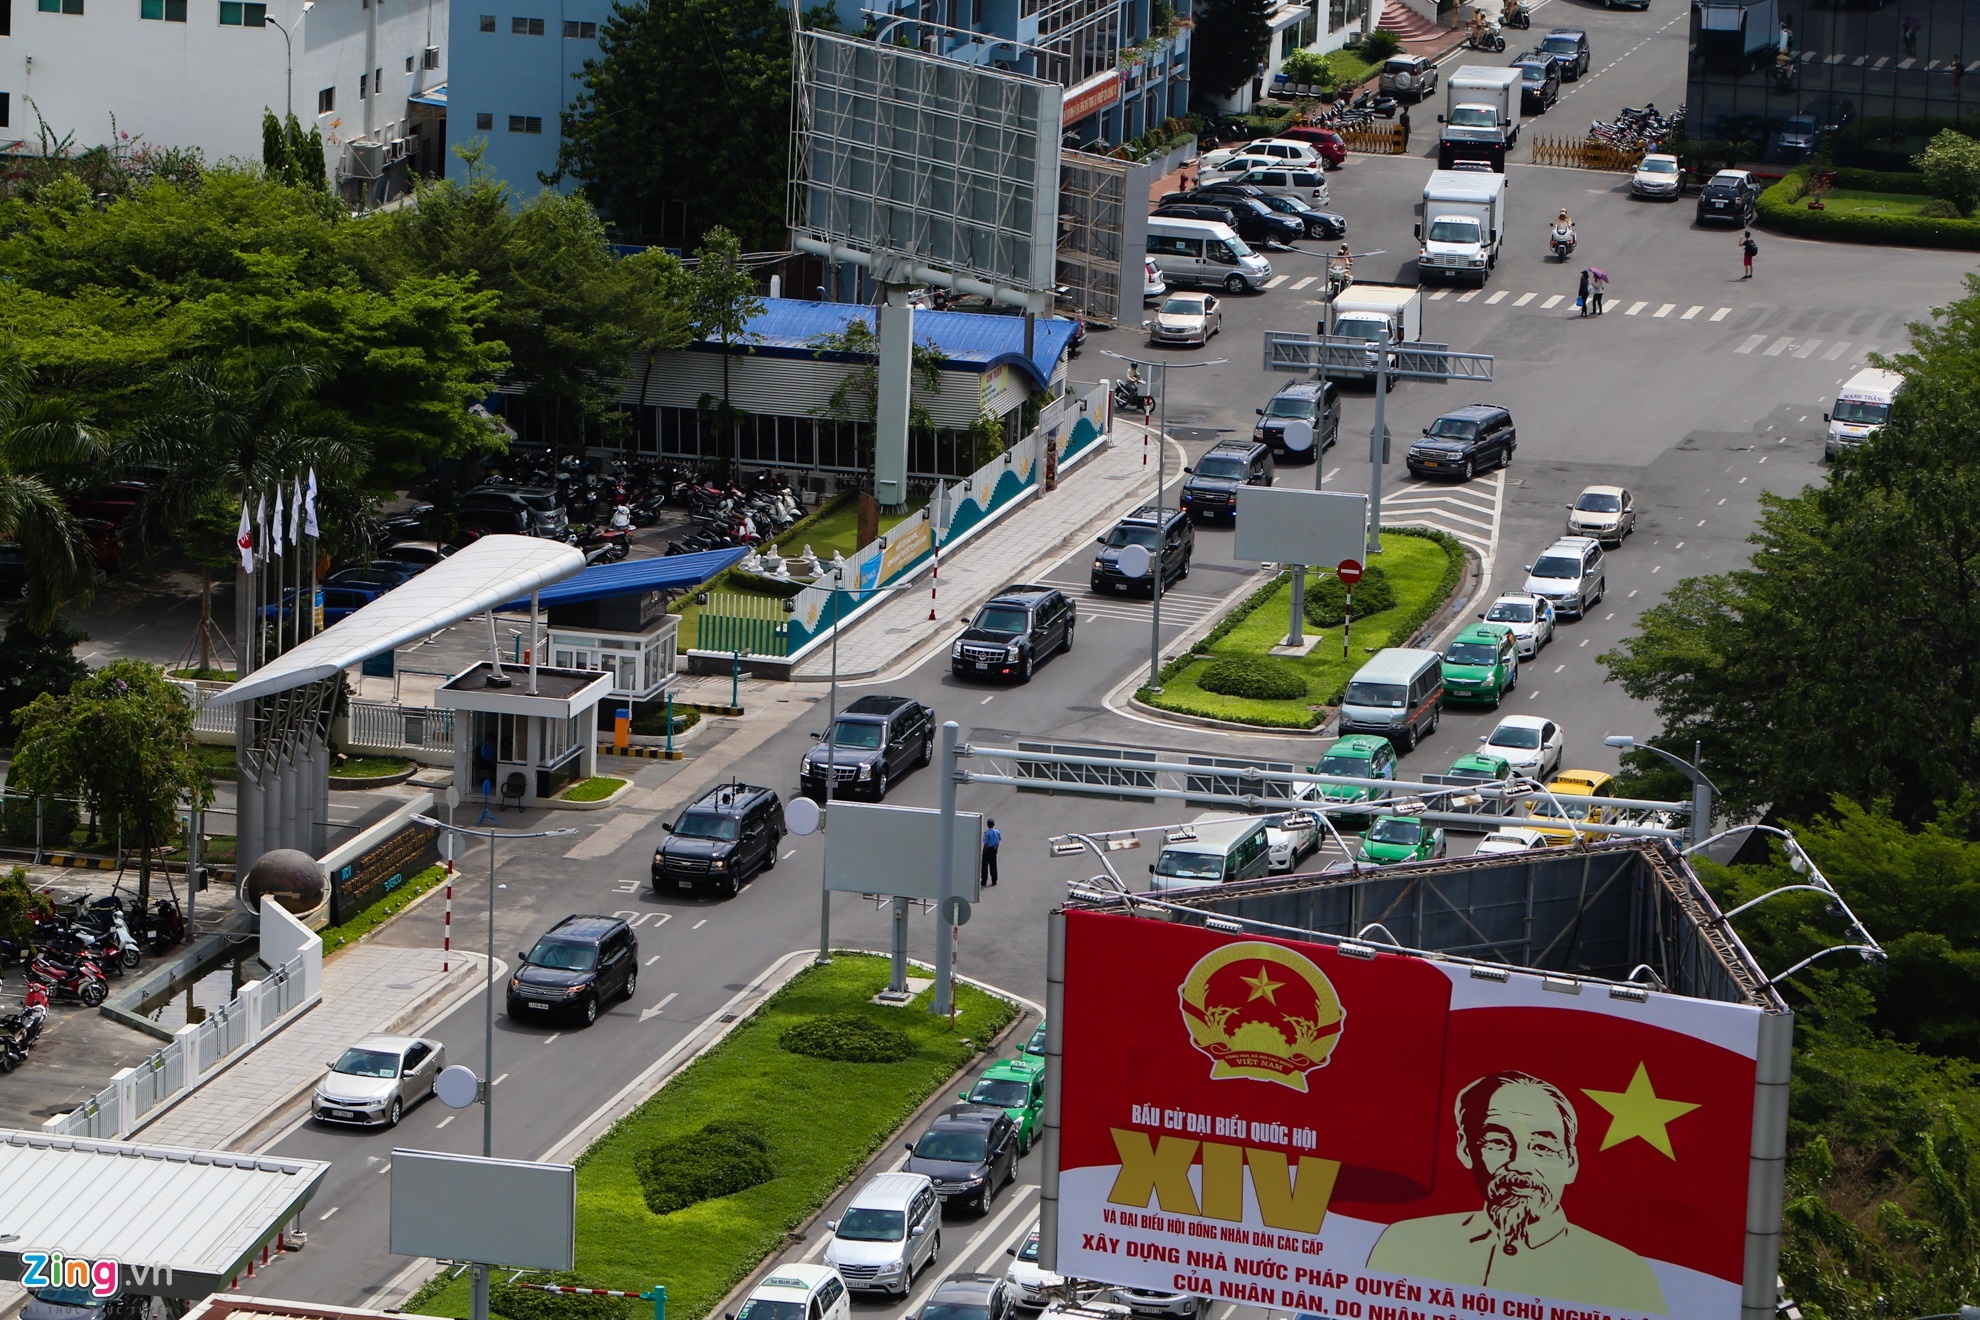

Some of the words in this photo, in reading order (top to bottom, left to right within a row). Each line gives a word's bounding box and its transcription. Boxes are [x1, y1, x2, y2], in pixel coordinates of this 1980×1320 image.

[384, 873, 402, 892] SASCO
[1236, 1057, 1258, 1066] VIỆT
[1261, 1059, 1283, 1071] NAM
[1132, 1102, 1160, 1127] BẦU
[1164, 1106, 1186, 1130] CỬ
[1187, 1112, 1211, 1136] ĐẠI
[1215, 1113, 1247, 1139] BIỂU
[1251, 1121, 1289, 1145] QUỐC
[1292, 1126, 1317, 1151] HỘI
[1107, 1127, 1342, 1235] XIV
[1103, 1207, 1117, 1224] VÀ
[1120, 1211, 1138, 1229] ĐẠI
[1141, 1212, 1164, 1232] BIỂU
[1167, 1217, 1185, 1236] HỘI
[1188, 1220, 1217, 1240] ĐỒNG
[1220, 1227, 1249, 1245] NHÂN
[1252, 1231, 1274, 1249] DÂN
[1277, 1234, 1299, 1253] CÁC
[1301, 1238, 1324, 1256] CẤP
[1082, 1232, 1120, 1254] XÂY
[1126, 1240, 1180, 1264] DỰNG
[1187, 1250, 1228, 1272] NHÀ
[1234, 1257, 1288, 1281] NƯỚC
[1295, 1266, 1349, 1290] PHÁP
[1355, 1276, 1421, 1302] QUYỀN
[1428, 1287, 1455, 1308] XÃ
[1462, 1292, 1496, 1316] HỘI
[1503, 1297, 1543, 1320] CHỦ
[1173, 1269, 1213, 1295] CỦA
[1219, 1281, 1275, 1305] NHÂN
[1281, 1290, 1329, 1315] DÂN,
[1335, 1299, 1362, 1319] DO
